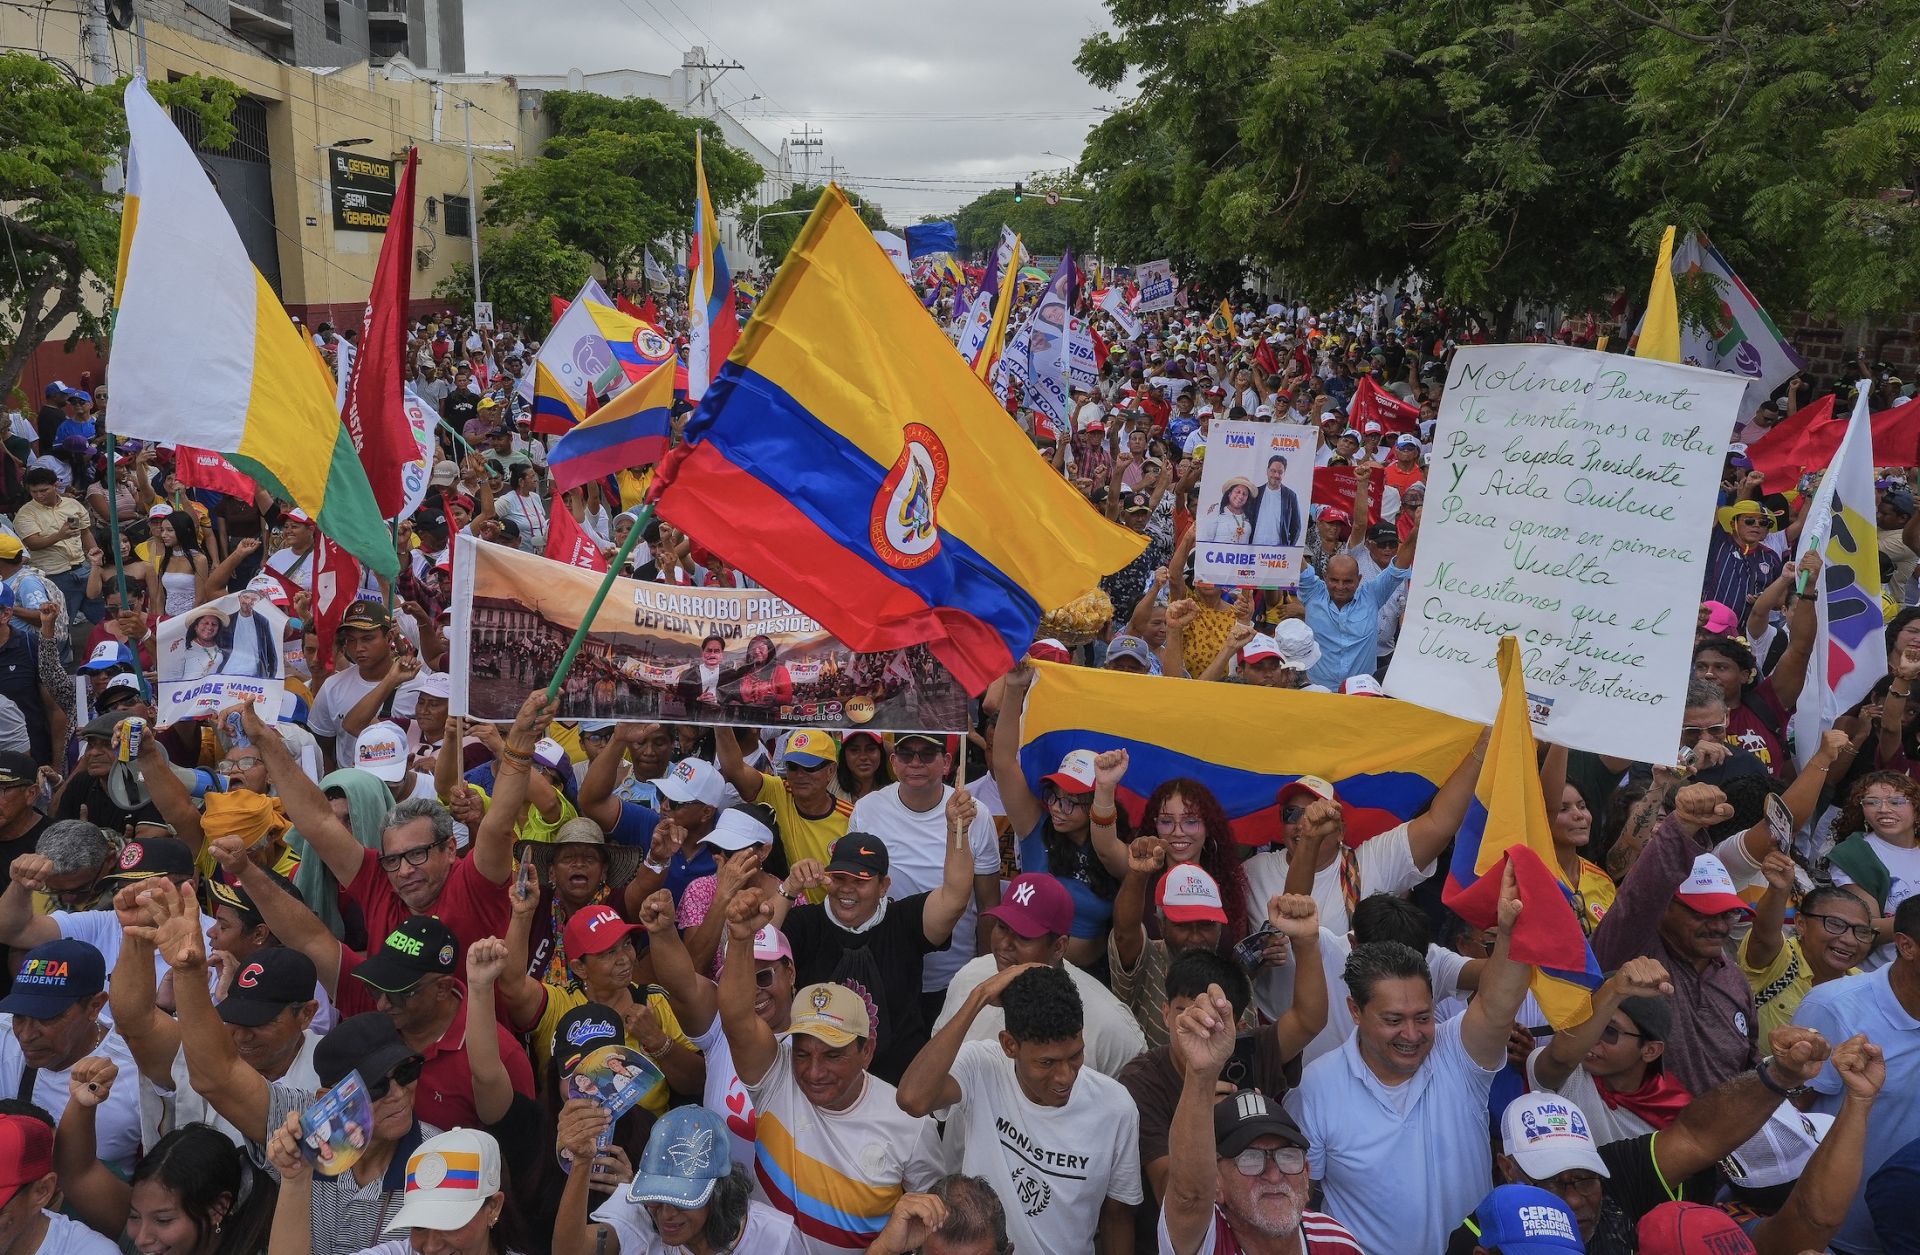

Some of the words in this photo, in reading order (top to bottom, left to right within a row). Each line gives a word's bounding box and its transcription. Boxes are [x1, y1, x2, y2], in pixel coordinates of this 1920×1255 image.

[337, 157, 348, 171] EL
[348, 159, 390, 178] GENERADOR
[345, 193, 368, 208] SERVI
[1449, 362, 1594, 395] Molinero
[1595, 370, 1700, 411] Presente
[1460, 395, 1491, 423] Te
[1634, 425, 1653, 441] a
[1661, 425, 1719, 456] votar
[922, 431, 935, 447] DE
[1271, 437, 1301, 449] AIDA
[1443, 430, 1495, 460] Por
[1501, 435, 1576, 478] Cepeda
[1580, 439, 1688, 488] Presidente
[1479, 468, 1552, 500] Aida
[871, 515, 893, 560] LIBERTAD
[902, 549, 935, 567] ORDEN
[1437, 496, 1497, 529] Para
[1503, 518, 1571, 552] ganar
[1576, 531, 1604, 547] en
[1608, 536, 1696, 563] primera
[1205, 551, 1256, 565] CARIBE
[1511, 540, 1618, 586] Vuelta
[633, 587, 741, 621] ALGARROBO
[1424, 561, 1561, 612] Necesitamos
[1570, 603, 1618, 637] que
[1630, 607, 1672, 636] el
[634, 607, 693, 635] CEPEDA
[694, 619, 705, 637] Y
[709, 621, 743, 639] AIDA
[746, 615, 823, 637] PRESIDEN
[1421, 597, 1521, 637] Cambio
[790, 664, 819, 673] PACTO
[1417, 627, 1478, 665] Viva
[1520, 647, 1568, 686] Pacto
[1568, 664, 1672, 707] Histórico
[172, 682, 224, 704] CARIBE
[781, 700, 843, 716] PACTO
[848, 703, 874, 712] 100%
[1012, 881, 1036, 906] NY
[588, 909, 621, 933] FILA
[238, 963, 265, 988] C
[566, 1017, 617, 1043] Colombia
[1537, 1102, 1568, 1116] IVÁN
[1547, 1117, 1568, 1125] AIDA
[995, 1116, 1090, 1170] MONASTERY
[1518, 1206, 1571, 1225] CEPEDA
[1522, 1219, 1574, 1235] PRESIDENTE
